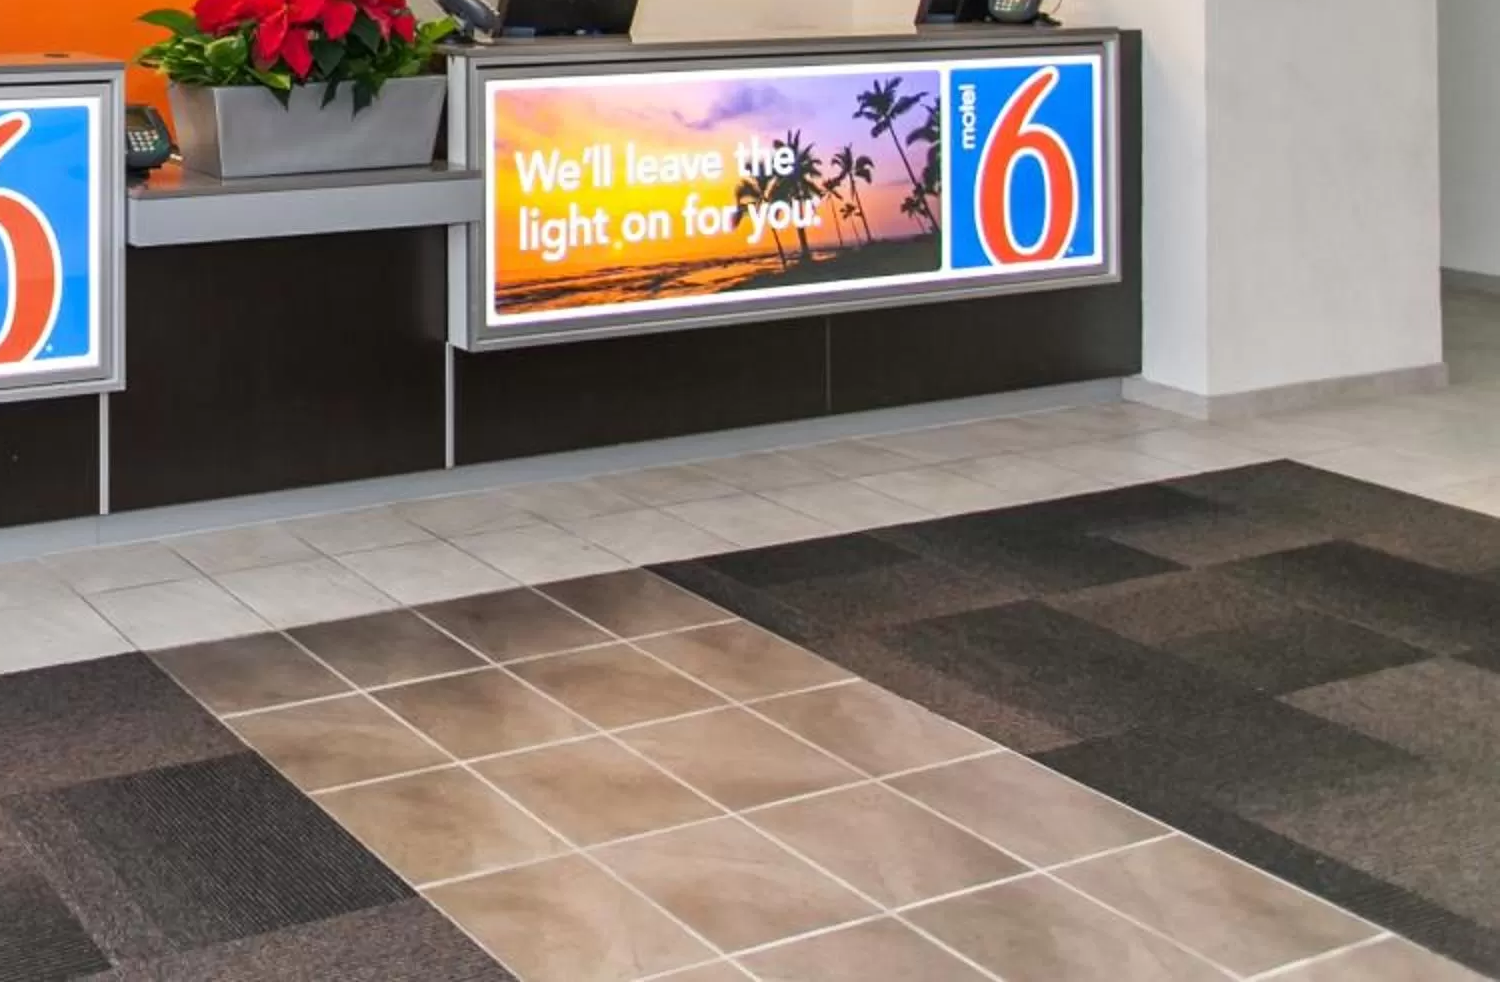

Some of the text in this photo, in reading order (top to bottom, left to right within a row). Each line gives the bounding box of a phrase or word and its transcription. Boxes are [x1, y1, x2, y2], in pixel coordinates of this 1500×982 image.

[958, 83, 976, 150] motel
[515, 135, 795, 193] We'll leave the
[974, 65, 1079, 266] 6
[518, 203, 609, 262] light
[621, 209, 670, 242] on
[681, 193, 739, 236] for
